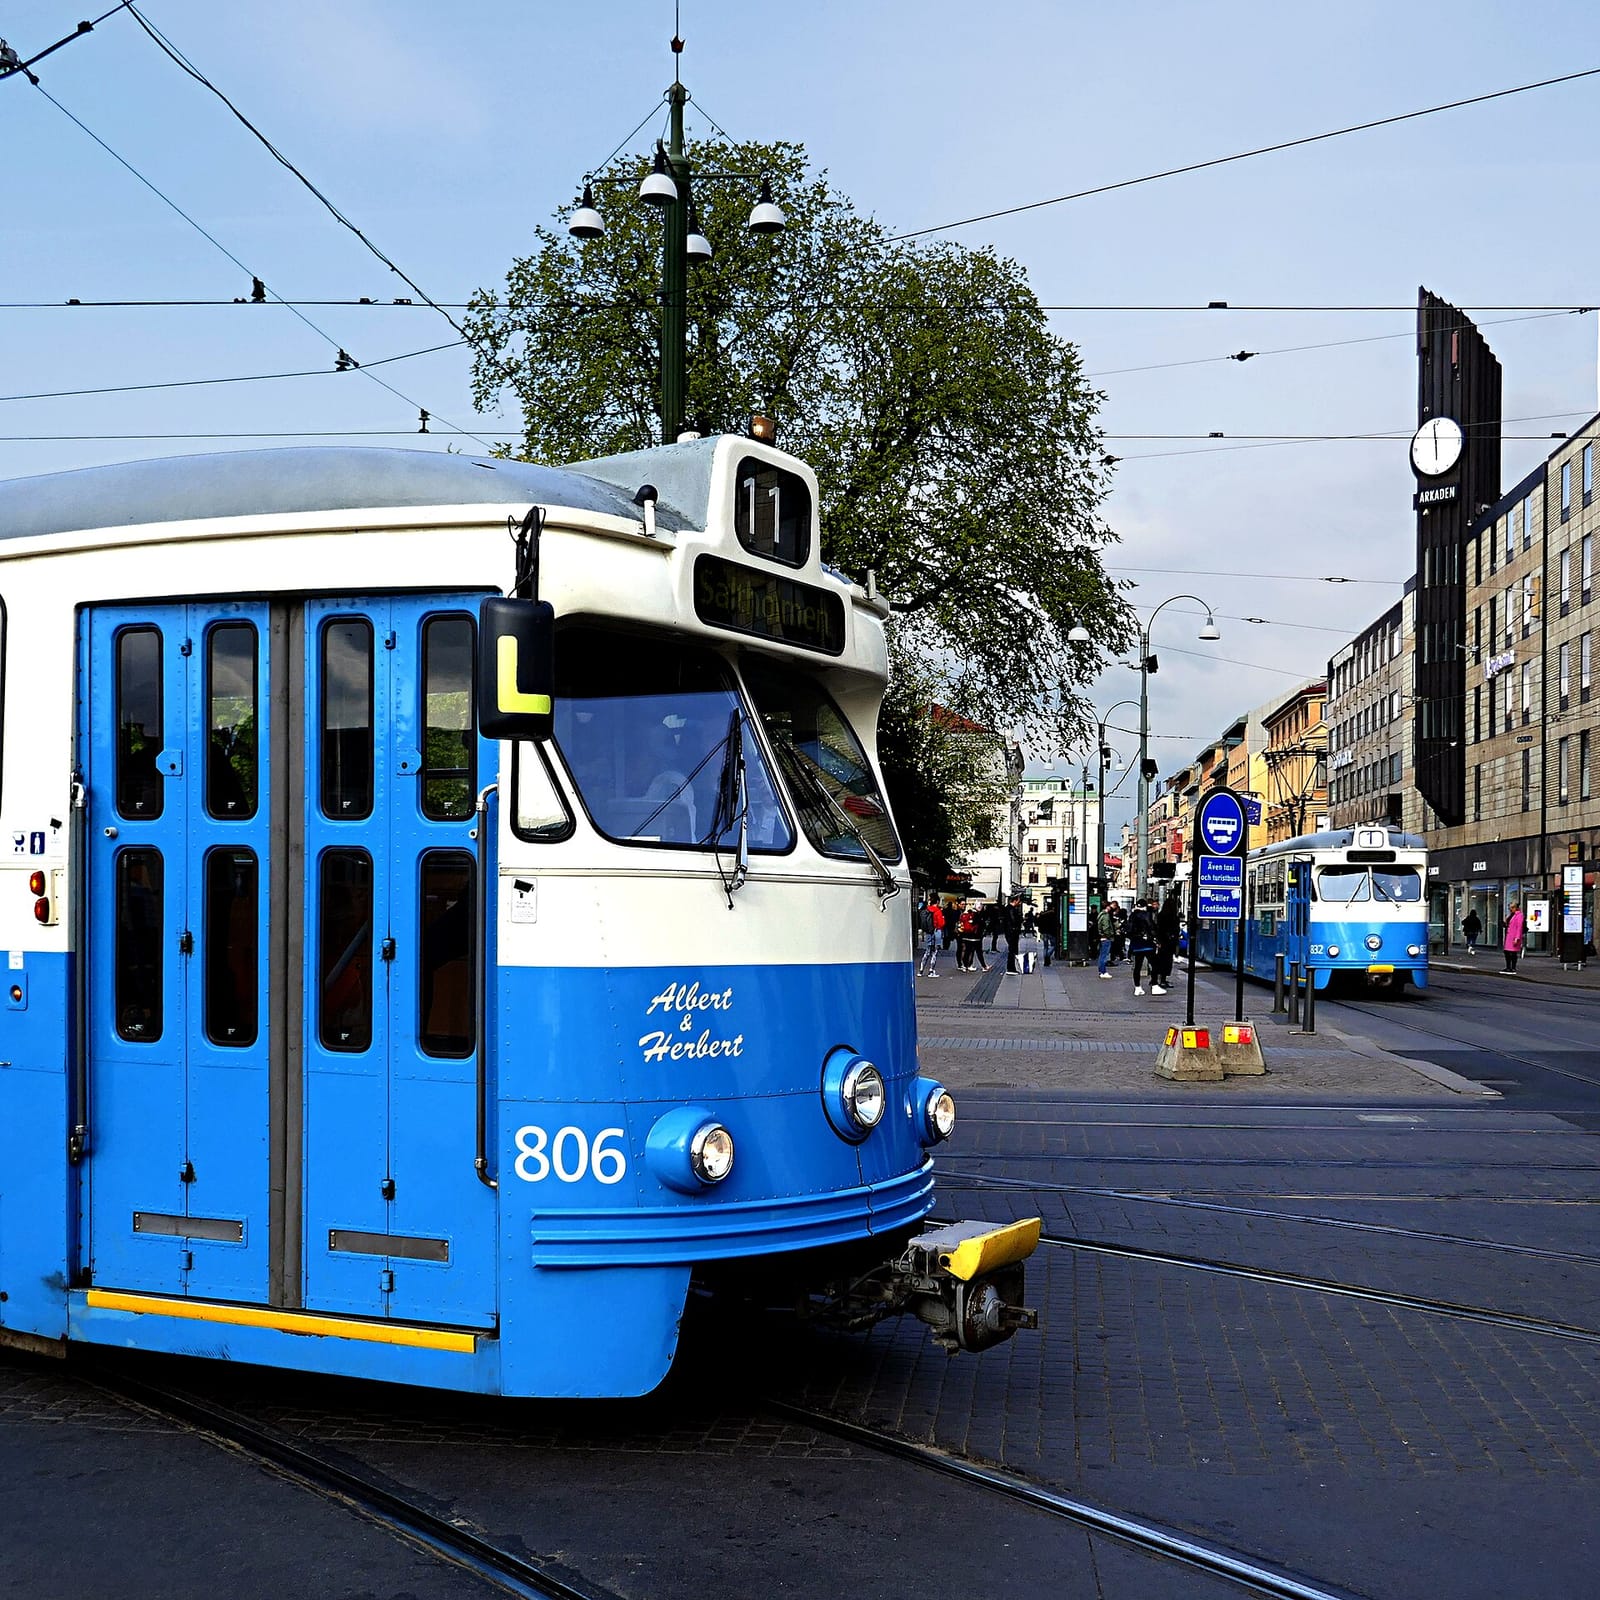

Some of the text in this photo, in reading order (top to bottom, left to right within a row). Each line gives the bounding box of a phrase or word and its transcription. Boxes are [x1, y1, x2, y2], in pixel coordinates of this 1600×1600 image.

[1419, 487, 1455, 503] ARKADEN
[743, 477, 780, 544] 11
[1207, 861, 1223, 870] Även
[1212, 874, 1240, 882] turistbuss
[1210, 893, 1230, 902] Gäller
[646, 981, 733, 1015] Albert
[679, 1013, 692, 1031] &
[638, 1029, 744, 1063] Herbert
[514, 1125, 627, 1185] 806
